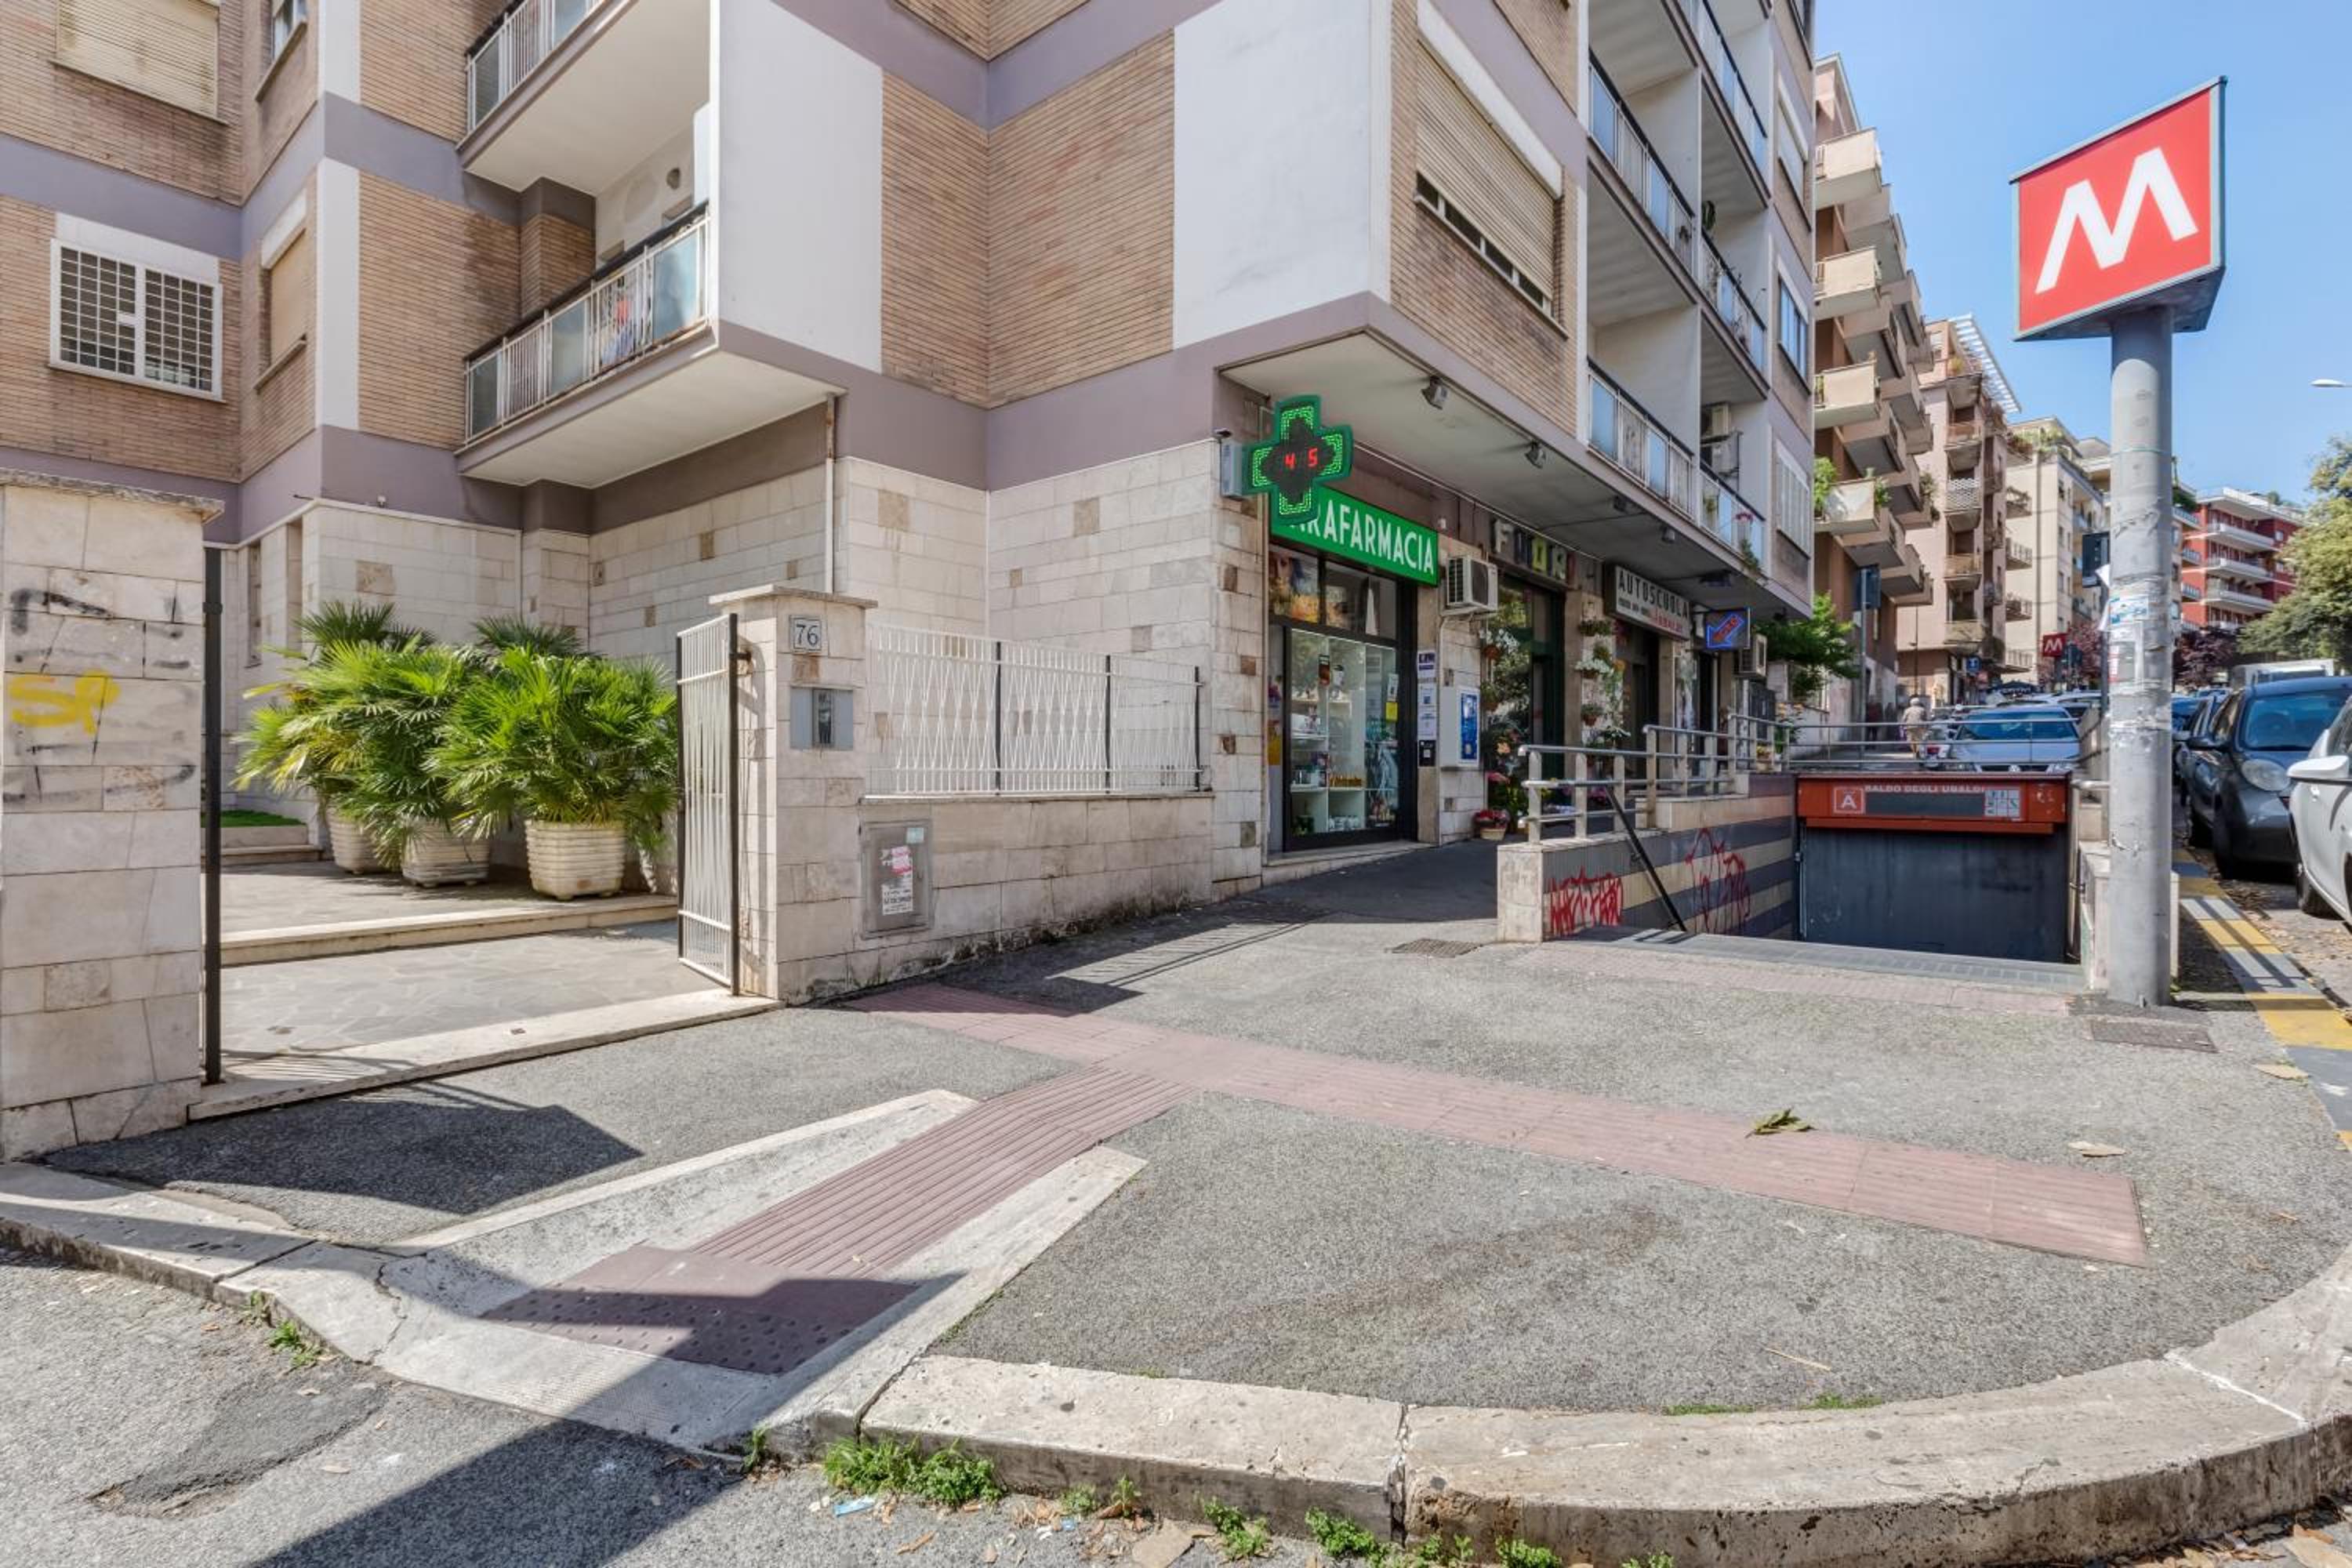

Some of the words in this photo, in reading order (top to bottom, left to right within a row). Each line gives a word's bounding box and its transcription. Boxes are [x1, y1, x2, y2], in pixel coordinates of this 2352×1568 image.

[2035, 146, 2199, 295] M
[1289, 499, 1435, 575] RAFARMACIA
[1618, 570, 1689, 619] AUTOSCUOLA
[796, 624, 819, 648] 76
[1841, 794, 1857, 809] A
